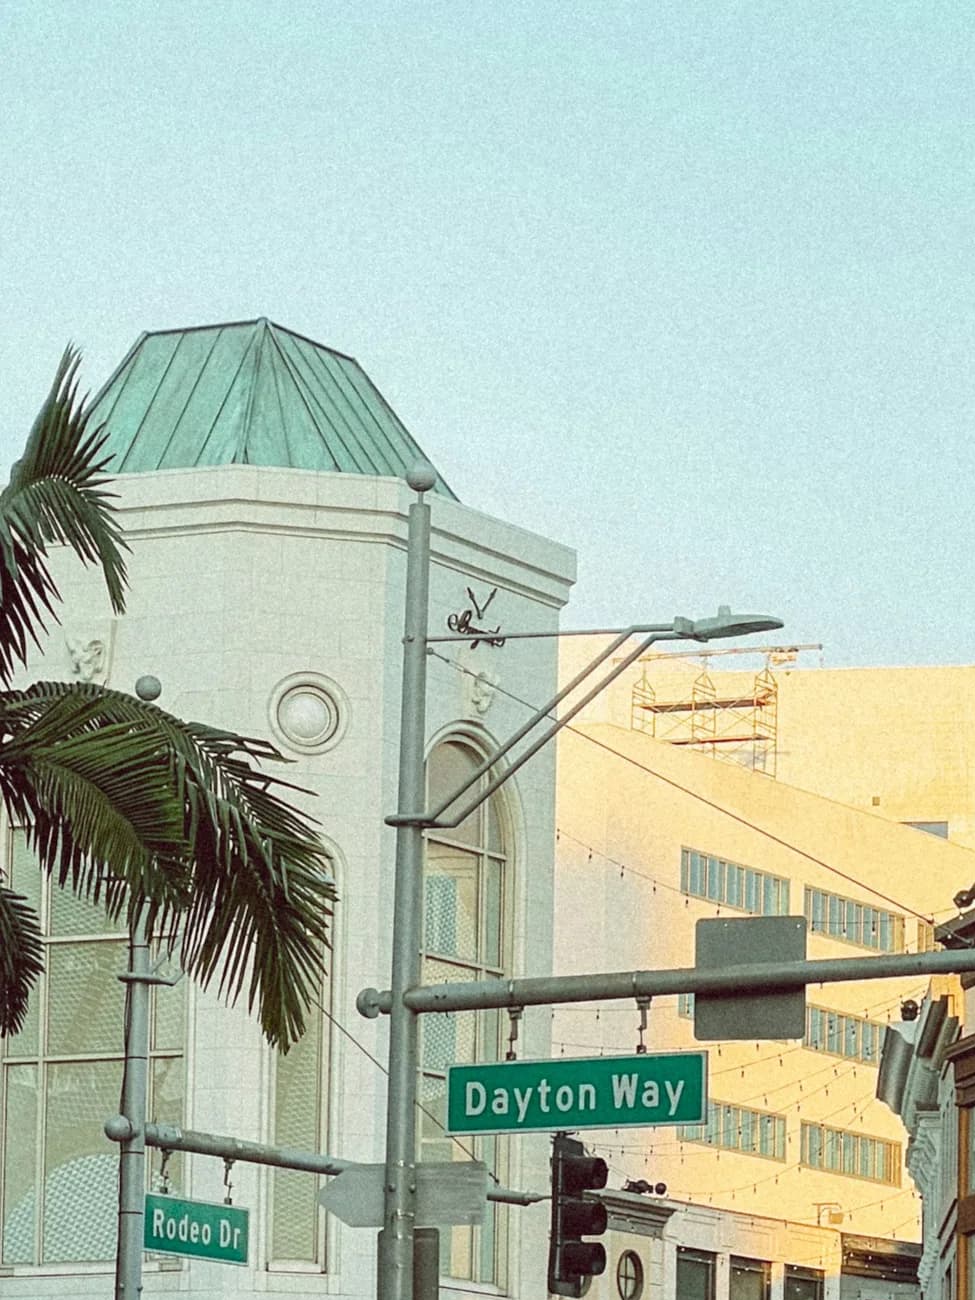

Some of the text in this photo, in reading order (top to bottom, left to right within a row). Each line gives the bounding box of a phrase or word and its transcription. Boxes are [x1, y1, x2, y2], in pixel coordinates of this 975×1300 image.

[465, 1073, 685, 1123] Dayton Way
[153, 1208, 241, 1250] Rodeo Dr
